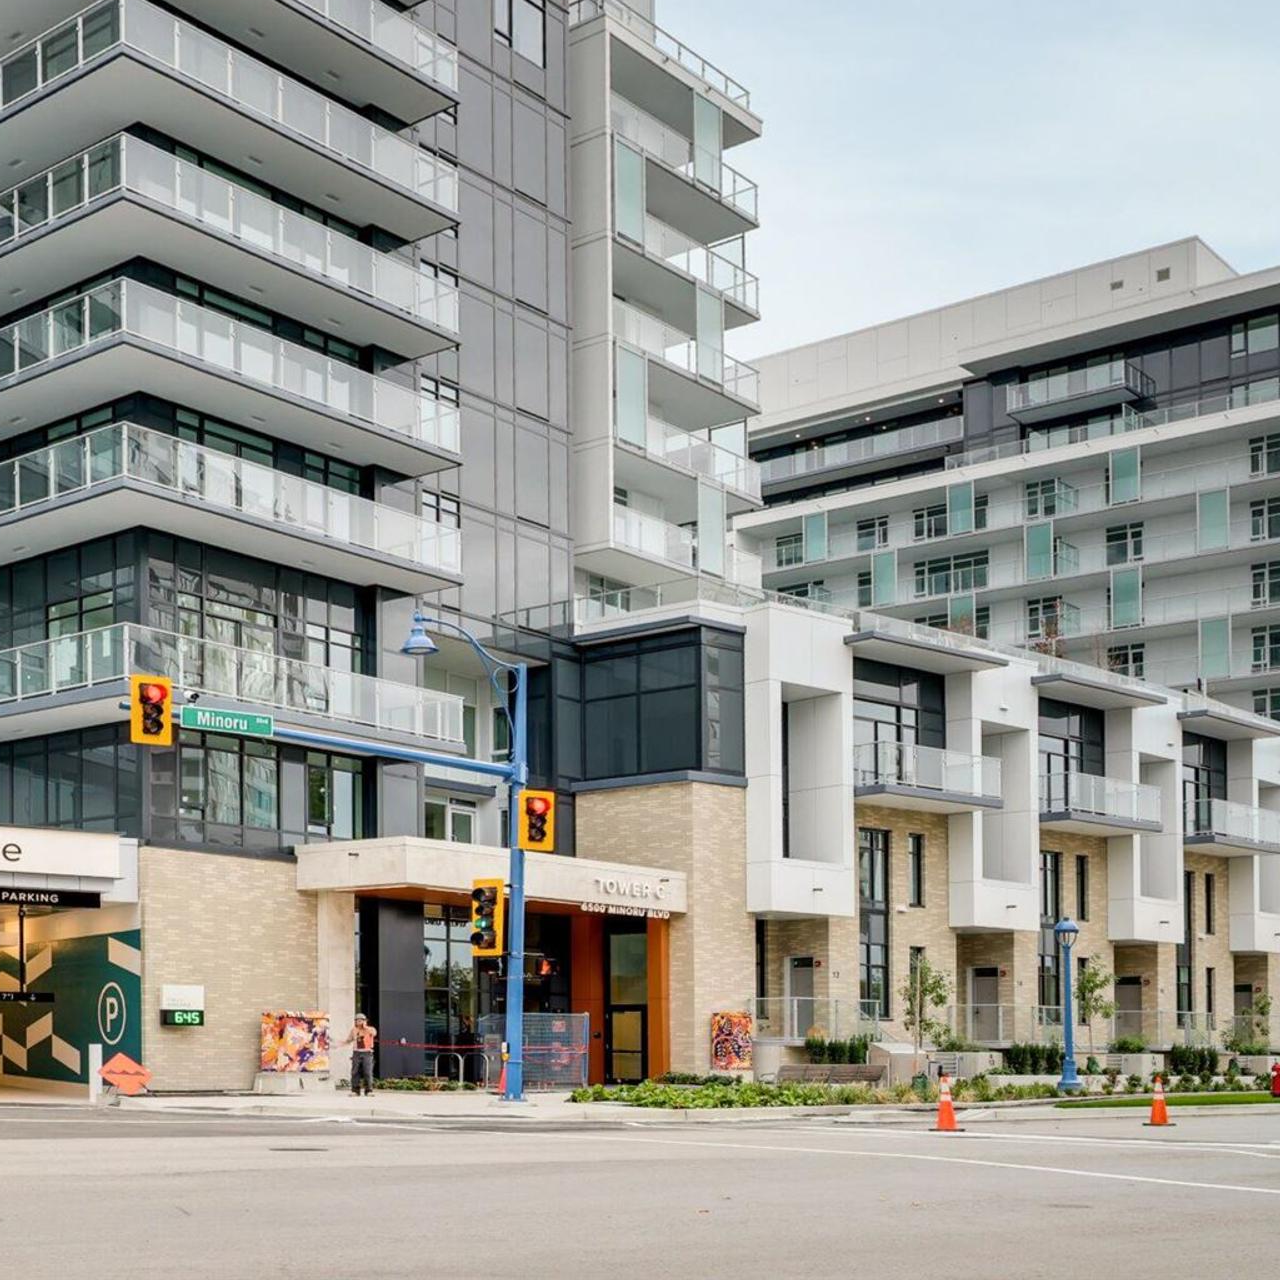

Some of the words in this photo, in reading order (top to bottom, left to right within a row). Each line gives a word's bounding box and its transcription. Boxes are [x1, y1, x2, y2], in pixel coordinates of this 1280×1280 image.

[196, 711, 248, 730] Minoru
[1, 891, 60, 904] PARKING
[595, 878, 651, 898] TOWER
[607, 904, 646, 918] MINORU
[646, 908, 671, 920] BLVD
[106, 997, 119, 1032] P
